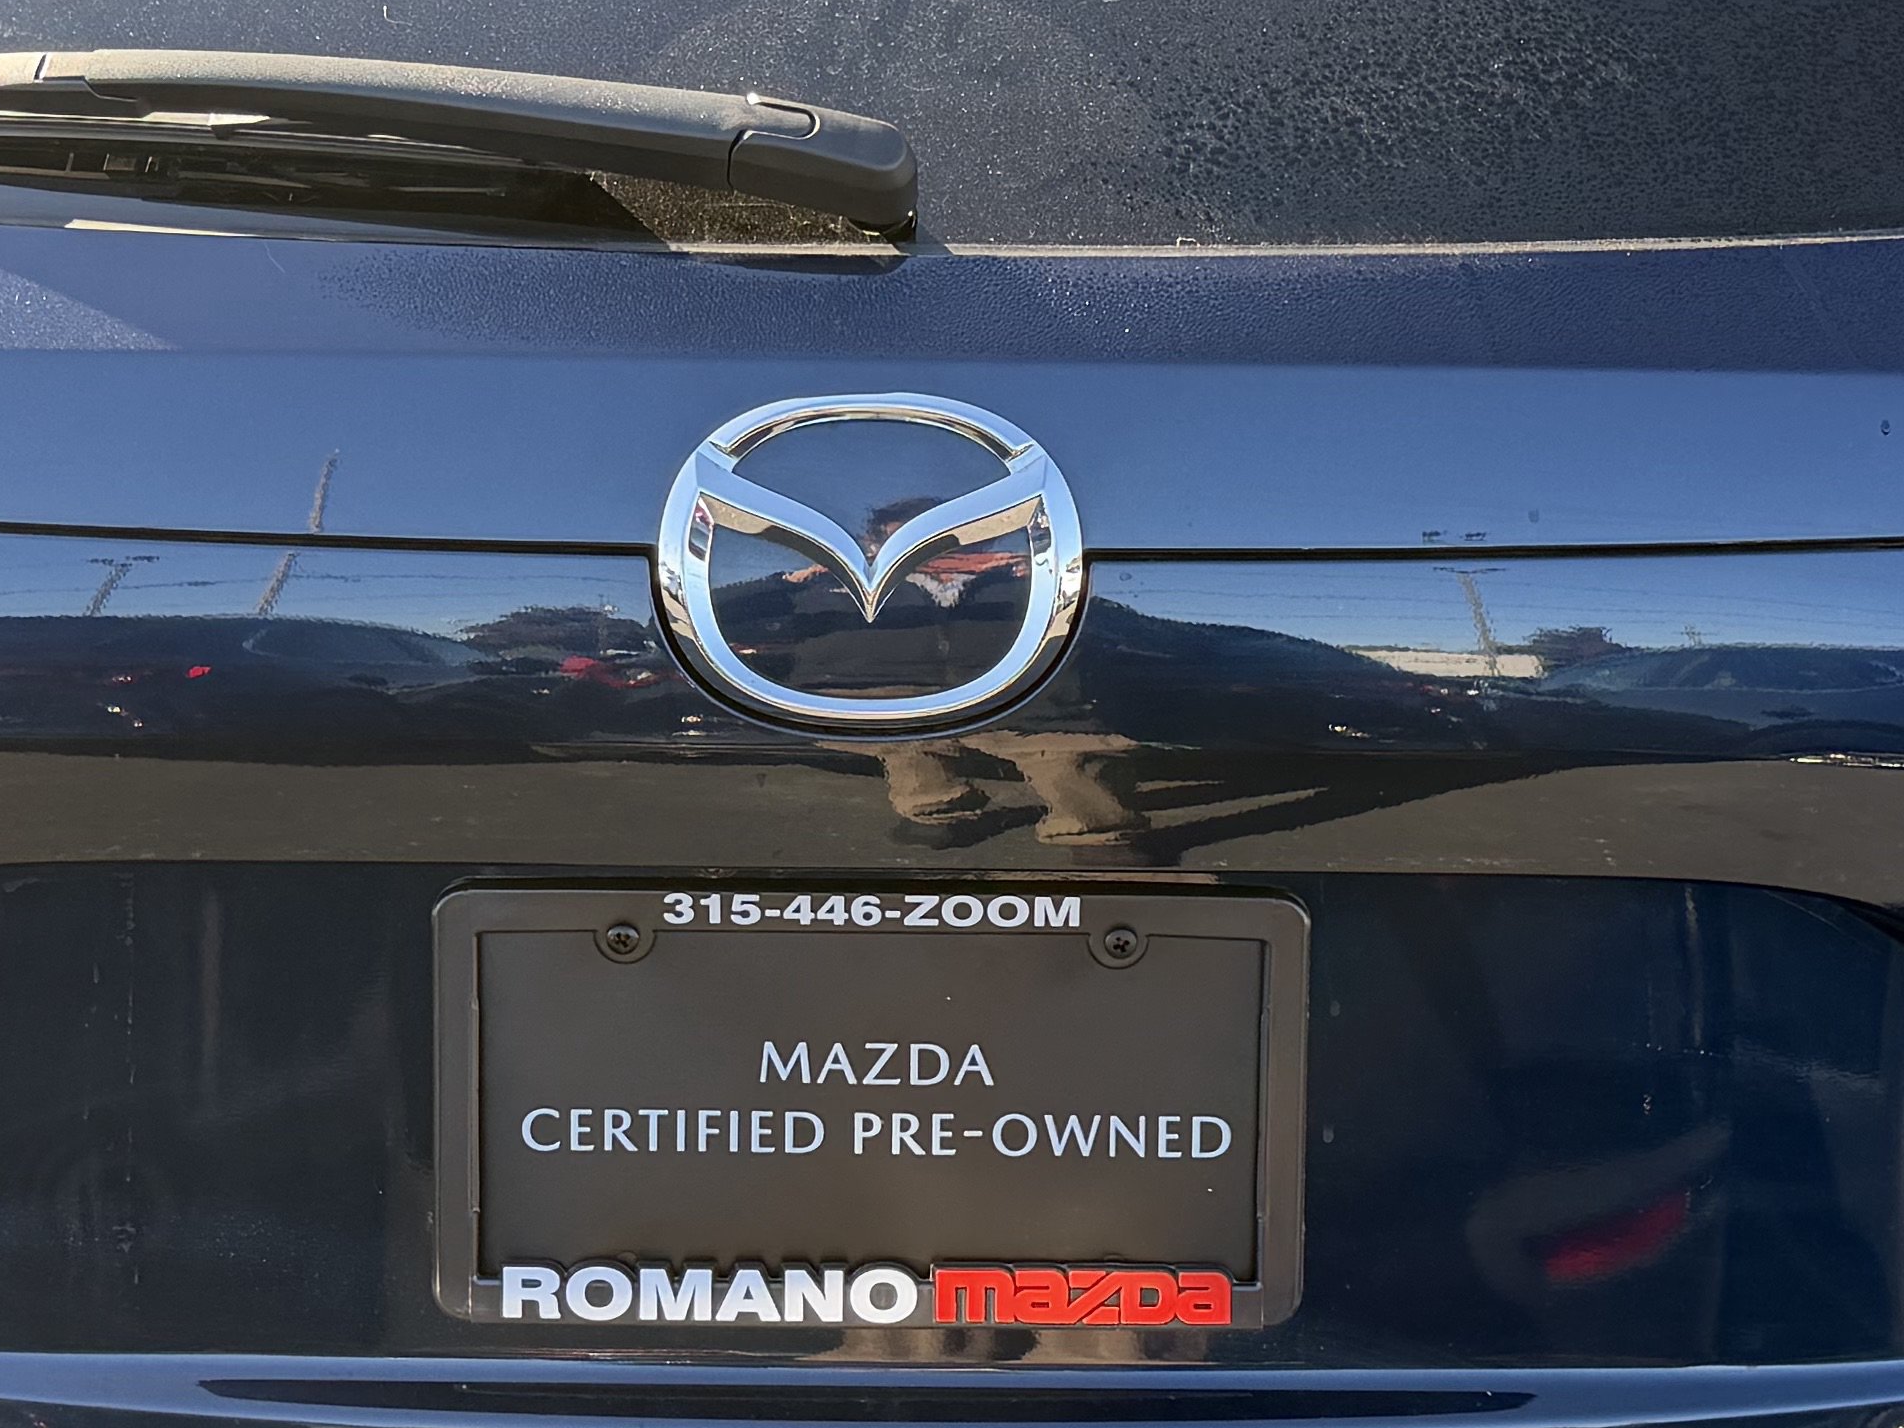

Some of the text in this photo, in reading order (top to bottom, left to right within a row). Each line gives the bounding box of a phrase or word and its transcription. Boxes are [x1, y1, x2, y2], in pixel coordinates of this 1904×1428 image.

[663, 892, 1082, 929] 315-446-ZOOM
[758, 1040, 995, 1087] MAZDA
[521, 1108, 1234, 1160] CERTIFIED PRE-OWNED
[501, 1265, 918, 1325] ROMANO
